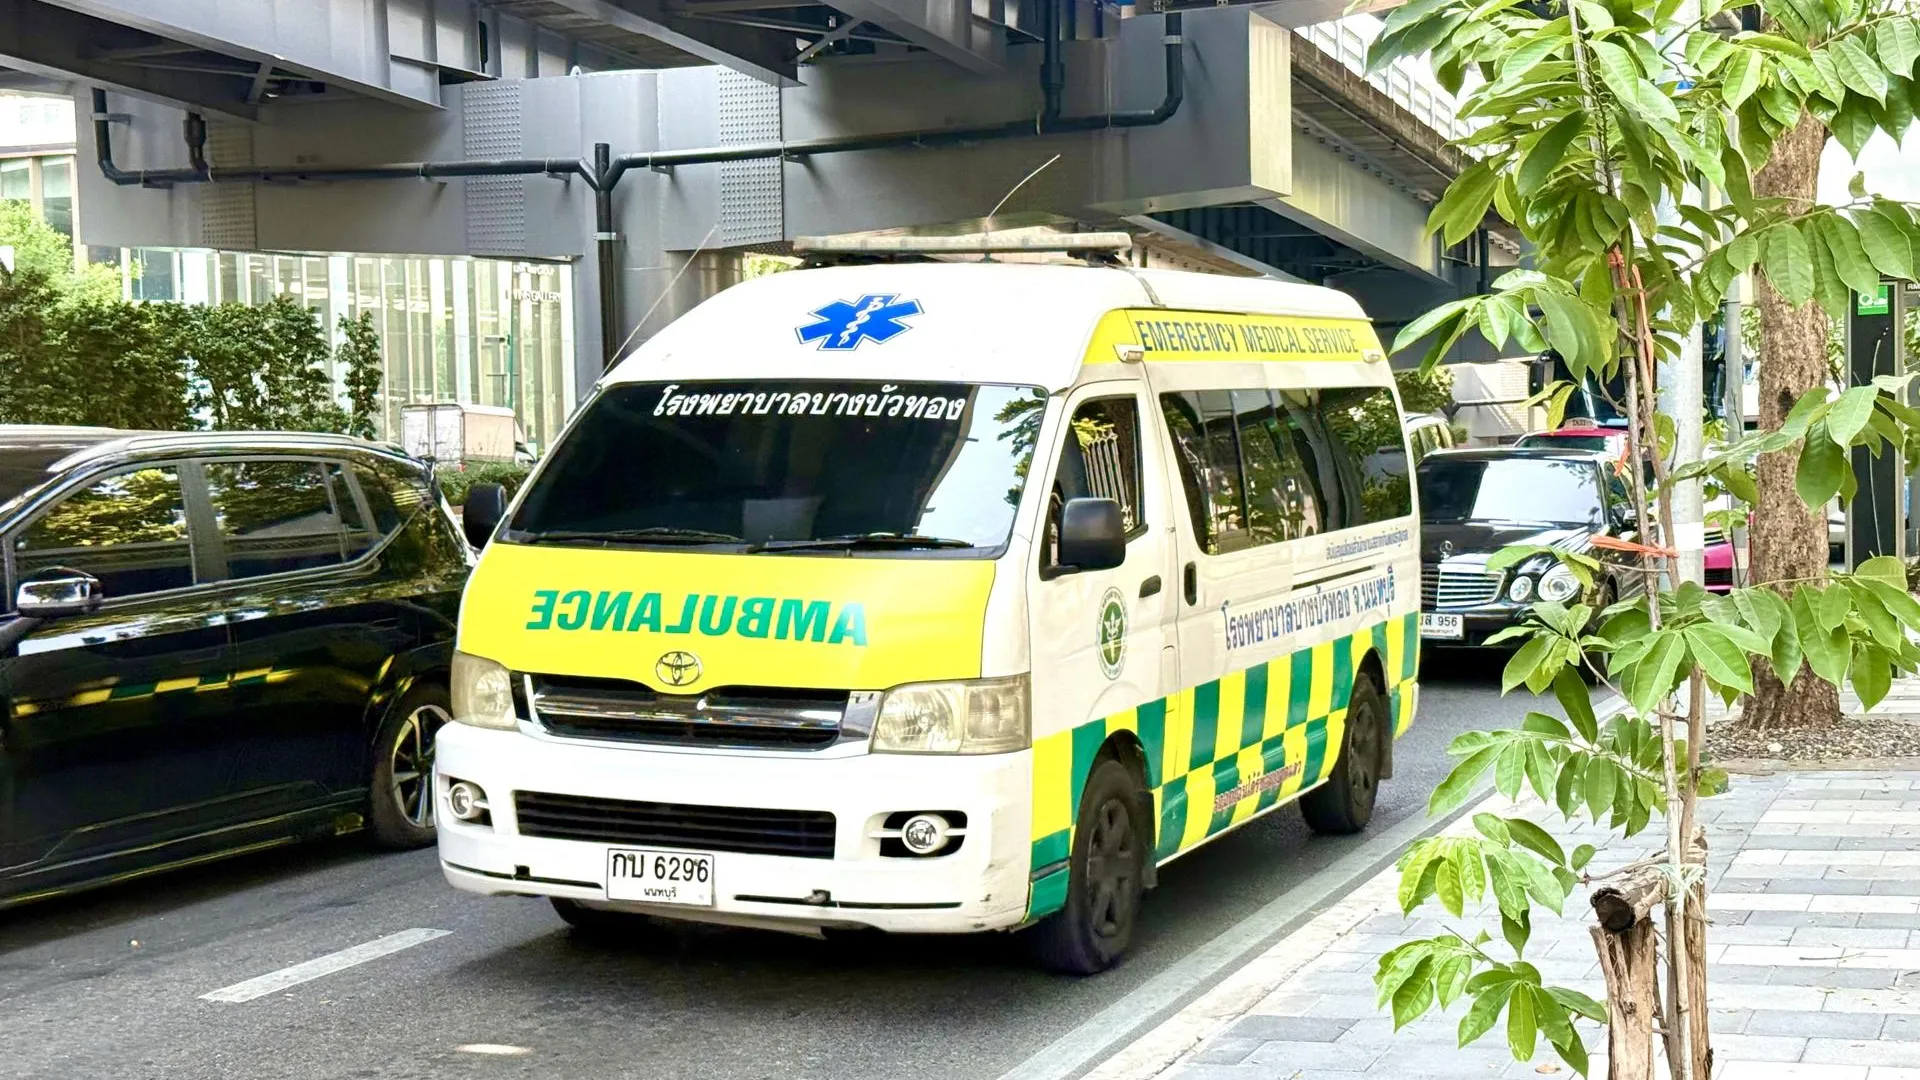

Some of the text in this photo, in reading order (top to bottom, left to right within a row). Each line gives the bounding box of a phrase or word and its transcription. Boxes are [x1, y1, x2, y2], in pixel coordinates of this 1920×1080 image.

[1136, 321, 1359, 354] EMERGENCY MEDICAL SERVICE
[653, 384, 966, 421] โรงพยาบาลบางบัวทอง
[1221, 563, 1396, 650] โรงพยาบาลบางบัวทอง จ.นนทบุรี
[1438, 615, 1458, 627] 956
[612, 853, 709, 883] กบ 6296
[644, 887, 678, 901] นนทบุรี
